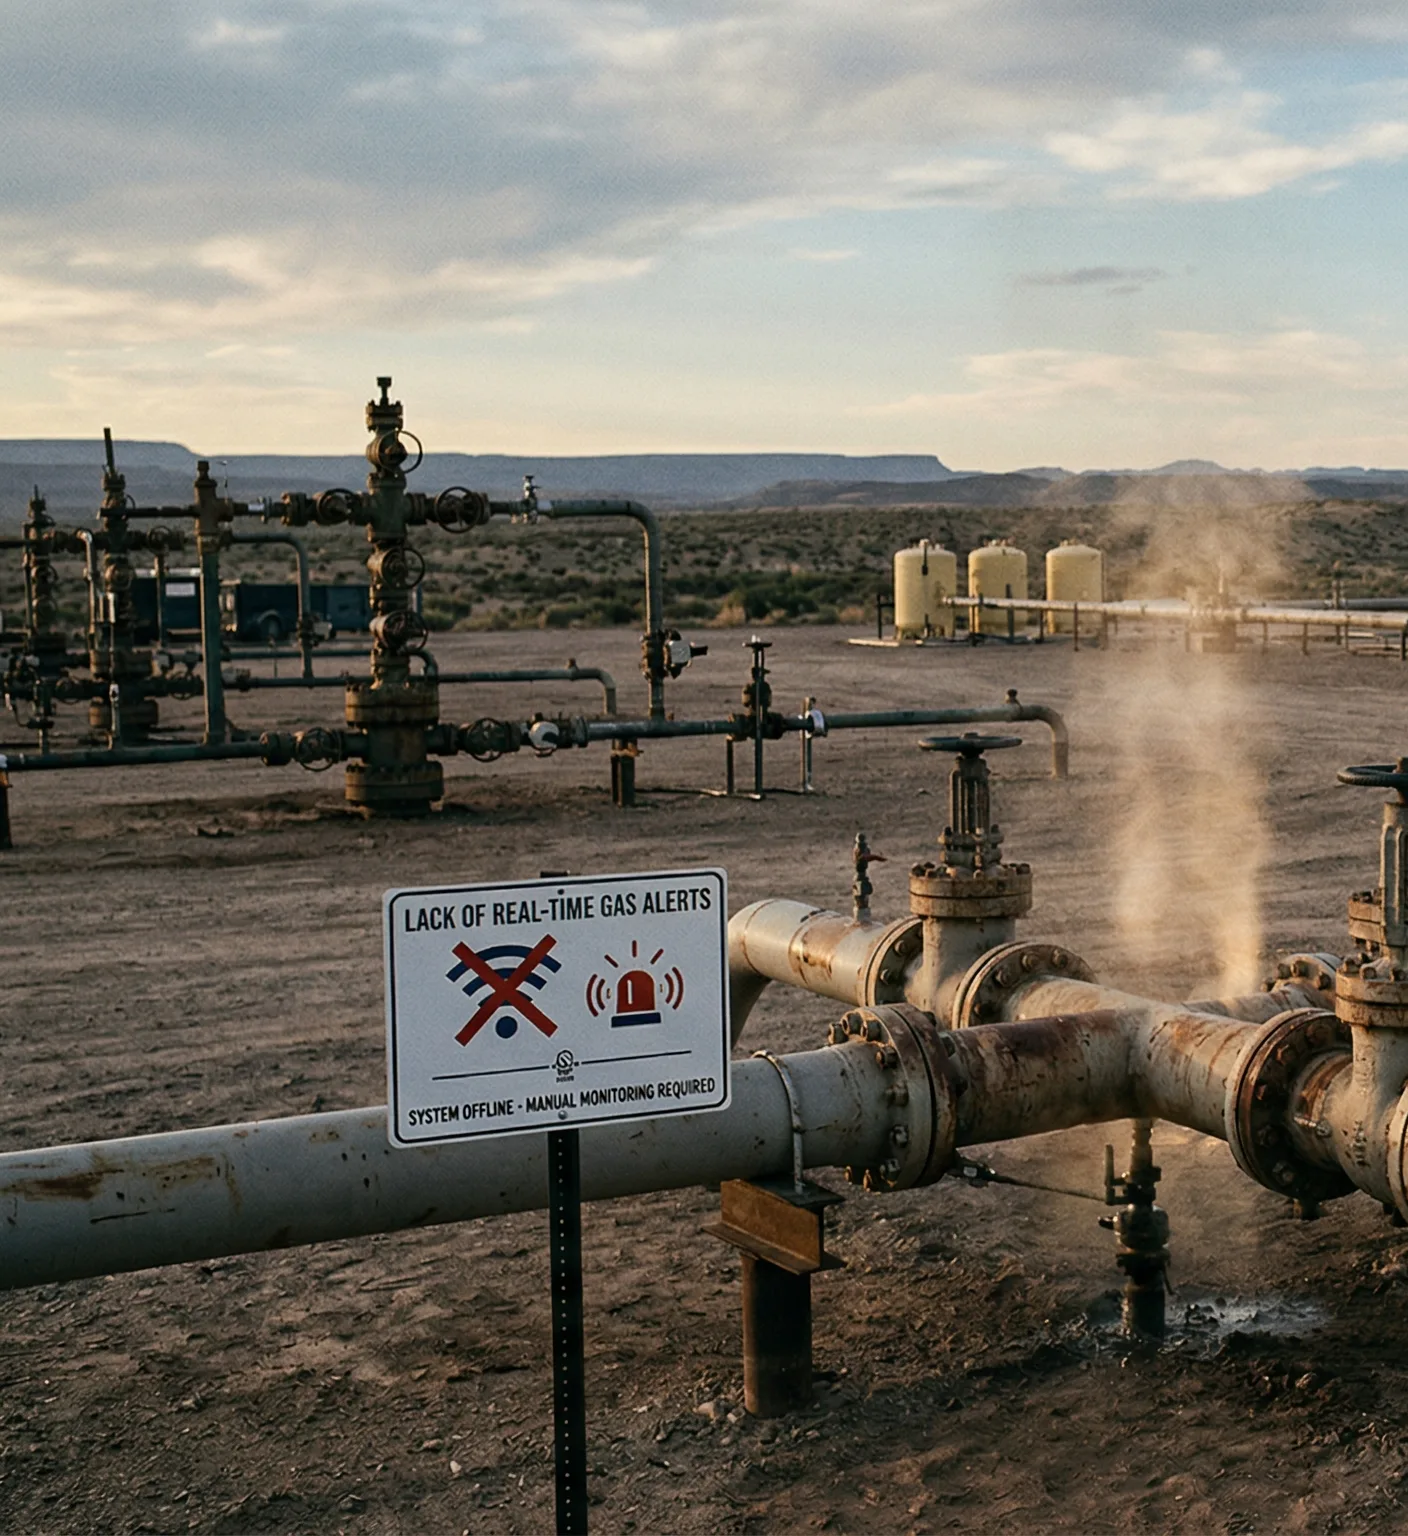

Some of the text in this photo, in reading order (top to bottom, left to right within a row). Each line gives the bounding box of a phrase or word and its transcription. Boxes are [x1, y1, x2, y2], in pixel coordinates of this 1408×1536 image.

[404, 887, 712, 933] LACK OF REAL-TIME GAS ALERTS
[408, 1104, 460, 1127] SYSTEM
[462, 1099, 515, 1120] OFFLINE
[525, 1092, 577, 1113] MANUAL
[579, 1083, 655, 1107] MONITORING
[657, 1077, 716, 1099] REQUIRED
